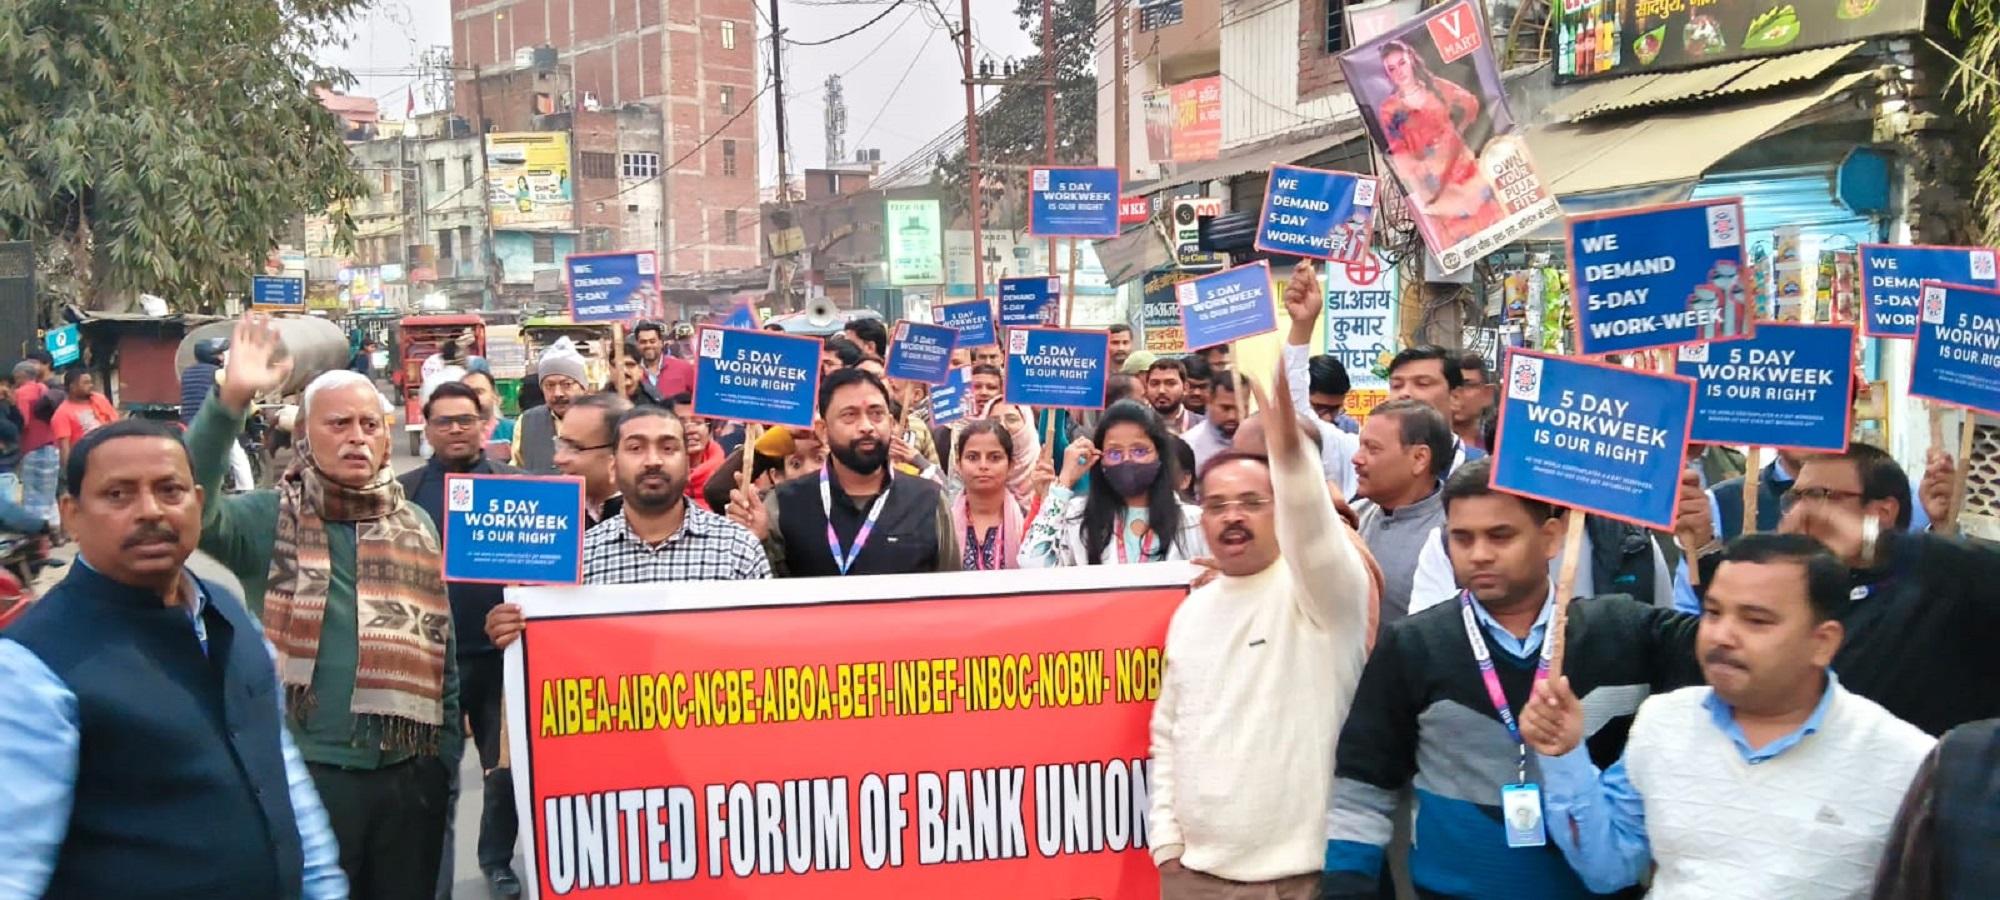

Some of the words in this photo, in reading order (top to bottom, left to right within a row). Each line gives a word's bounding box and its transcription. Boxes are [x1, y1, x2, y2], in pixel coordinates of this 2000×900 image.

[1438, 10, 1461, 39] V
[1443, 32, 1479, 55] MART
[1277, 178, 1298, 190] WE
[1499, 163, 1532, 187] YOUR
[1059, 183, 1066, 191] 5
[1068, 183, 1093, 191] DAY
[1505, 179, 1535, 199] PUJA
[1043, 192, 1111, 201] WORKWEEK
[1273, 195, 1329, 212] DEMAND
[1514, 192, 1538, 211] FITS
[1078, 203, 1105, 211] RIGHT
[1269, 212, 1308, 227] 5-DAY
[1267, 229, 1349, 251] WORK-WEEK
[1581, 234, 1619, 254] WE
[1584, 256, 1676, 282] DEMAND
[1871, 257, 1898, 270] WE
[1207, 290, 1215, 299] 5
[1217, 283, 1240, 296] DAY
[1873, 276, 1941, 289] DEMA
[1192, 288, 1263, 312] WORKWEEK
[1588, 288, 1649, 311] 5-DAY
[1873, 295, 1921, 307] 5-DAY
[958, 311, 973, 319] DAY
[1003, 313, 1050, 321] WORK-WEEK
[1210, 308, 1228, 318] OUR
[1230, 300, 1256, 313] RIGHT
[1332, 316, 1386, 341] कुमार
[1590, 307, 1724, 340] WORK-WEEK
[1958, 313, 1969, 327] 5
[738, 349, 745, 360] 5
[750, 351, 781, 364] DAY
[1039, 345, 1046, 355] 5
[1050, 346, 1076, 356] DAY
[1729, 348, 1742, 364] 5
[1749, 349, 1796, 366] DAY
[1940, 345, 1950, 359] IS
[1954, 348, 1979, 364] OUR
[714, 359, 807, 380] WORKWEEK
[1020, 355, 1097, 369] WORKWEEK
[720, 375, 730, 384] IS
[734, 376, 758, 387] OUR
[761, 380, 796, 391] RIGHT
[1026, 369, 1035, 377] IS
[1037, 369, 1057, 377] OUR
[1060, 369, 1088, 380] RIGHT
[1698, 364, 1834, 386] WORKWEEK
[1707, 384, 1721, 397] IS
[1726, 385, 1761, 399] OUR
[1766, 387, 1817, 401] RIGHT
[1560, 390, 1575, 408] 5
[1581, 393, 1629, 418] DAY
[1528, 403, 1668, 448] WORKWEEK
[1534, 428, 1550, 445] IS
[1555, 434, 1590, 453] OUR
[1595, 441, 1649, 465] RIGHT
[489, 499, 499, 512] 5
[504, 500, 539, 514] DAY
[465, 512, 568, 530] WORKWEEK
[472, 530, 484, 541] IS
[488, 531, 514, 542] OUR
[518, 532, 557, 544] RIGHT
[544, 785, 698, 895] UNITED
[704, 776, 850, 878] FORUM
[859, 772, 908, 870] OF
[916, 765, 1029, 865] BANK
